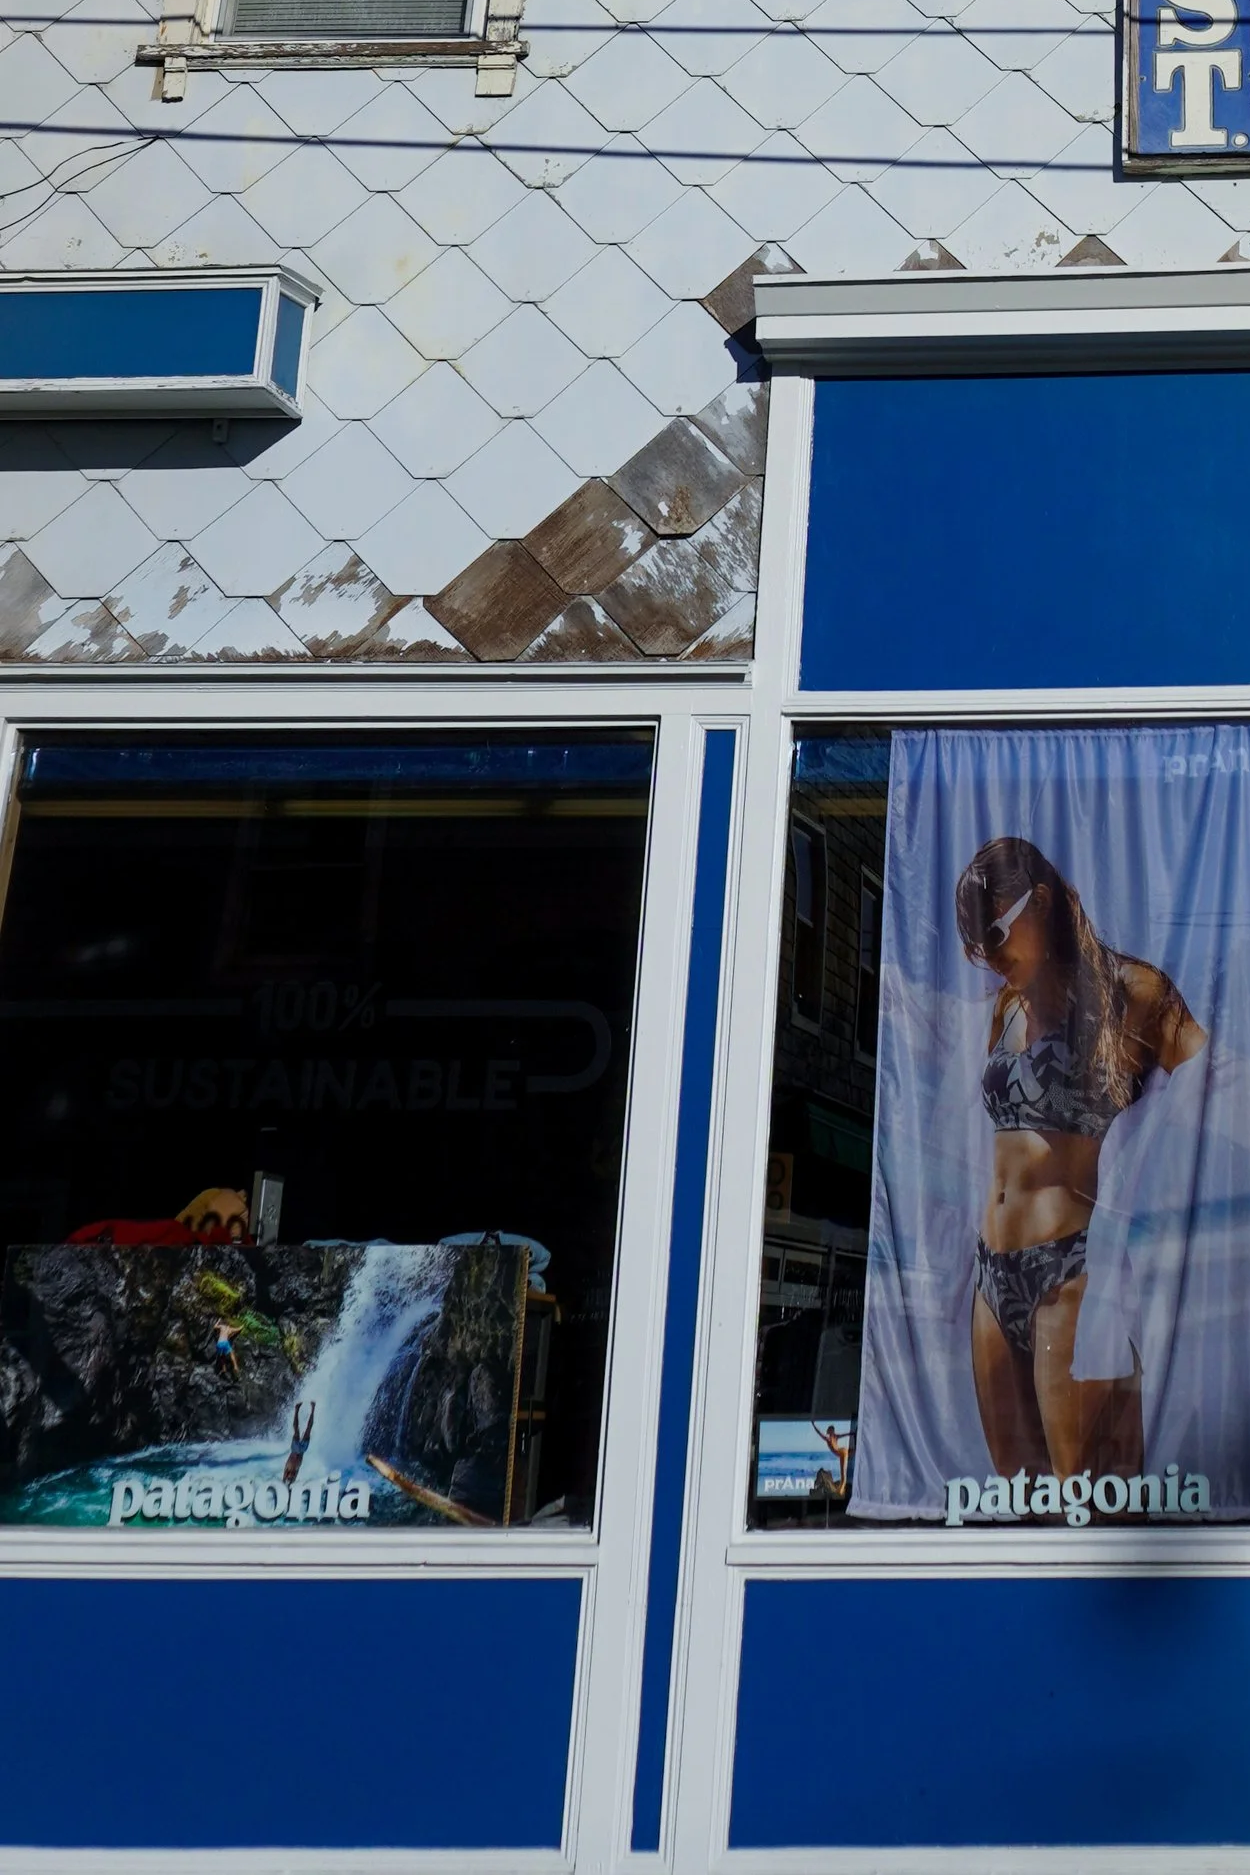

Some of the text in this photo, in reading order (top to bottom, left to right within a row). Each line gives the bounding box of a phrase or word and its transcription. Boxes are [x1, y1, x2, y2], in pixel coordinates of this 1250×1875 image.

[252, 980, 382, 1033] 100%
[104, 1057, 521, 1111] SUSTAINABLE
[106, 1470, 371, 1527] patagonia
[763, 1475, 815, 1494] prAna
[945, 1463, 1211, 1527] patagonia
